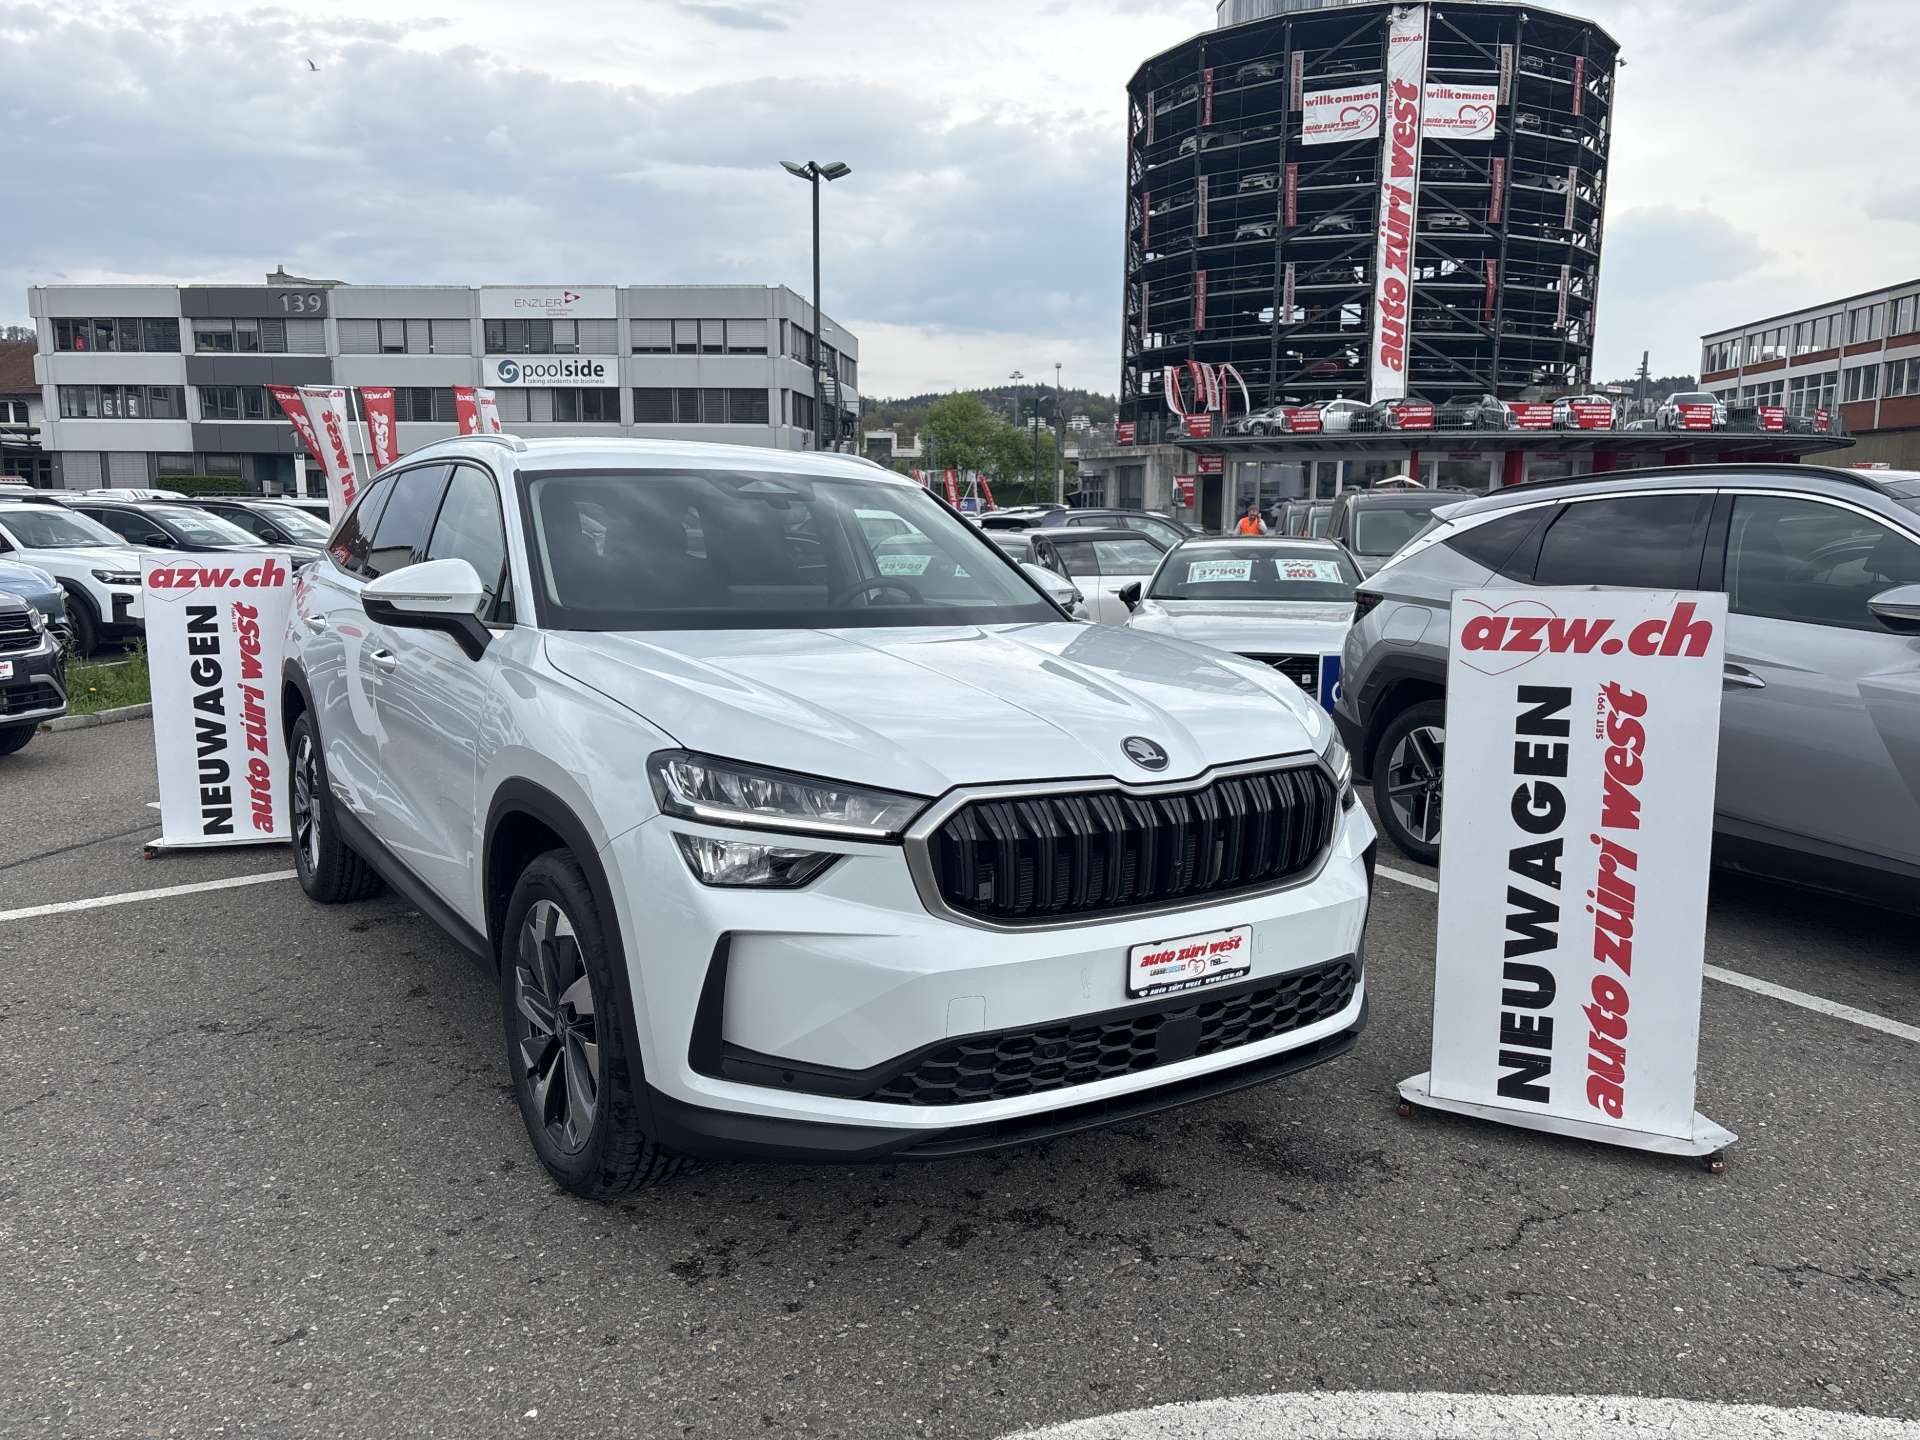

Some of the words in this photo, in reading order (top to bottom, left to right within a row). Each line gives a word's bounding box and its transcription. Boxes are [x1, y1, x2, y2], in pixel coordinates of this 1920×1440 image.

[1304, 91, 1379, 107] willkommen
[1426, 88, 1496, 101] willkommen
[1390, 77, 1419, 178] west
[1380, 182, 1413, 276] züri
[278, 293, 322, 312] 139
[514, 298, 563, 308] ENZLER
[1378, 276, 1407, 373] auto
[522, 359, 605, 384] poolside
[148, 558, 287, 589] azw.ch
[231, 600, 263, 680] west
[1460, 602, 1714, 658] azw.ch
[185, 604, 234, 836] NEUWAGEN
[237, 682, 269, 757] züri
[1595, 717, 1605, 740] SEIT
[1596, 691, 1606, 716] 1991
[1599, 680, 1648, 830] west
[243, 758, 274, 834] auto
[1496, 684, 1573, 1104] NEUWAGEN
[1585, 833, 1638, 977] züri
[1140, 948, 1176, 967] auto
[1176, 941, 1210, 961] züri
[1209, 935, 1242, 955] west
[1149, 986, 1167, 995] auto
[1168, 982, 1185, 992] züri
[1185, 980, 1202, 988] west
[1205, 969, 1244, 984] www.azw.ch
[1580, 974, 1631, 1120] auto
